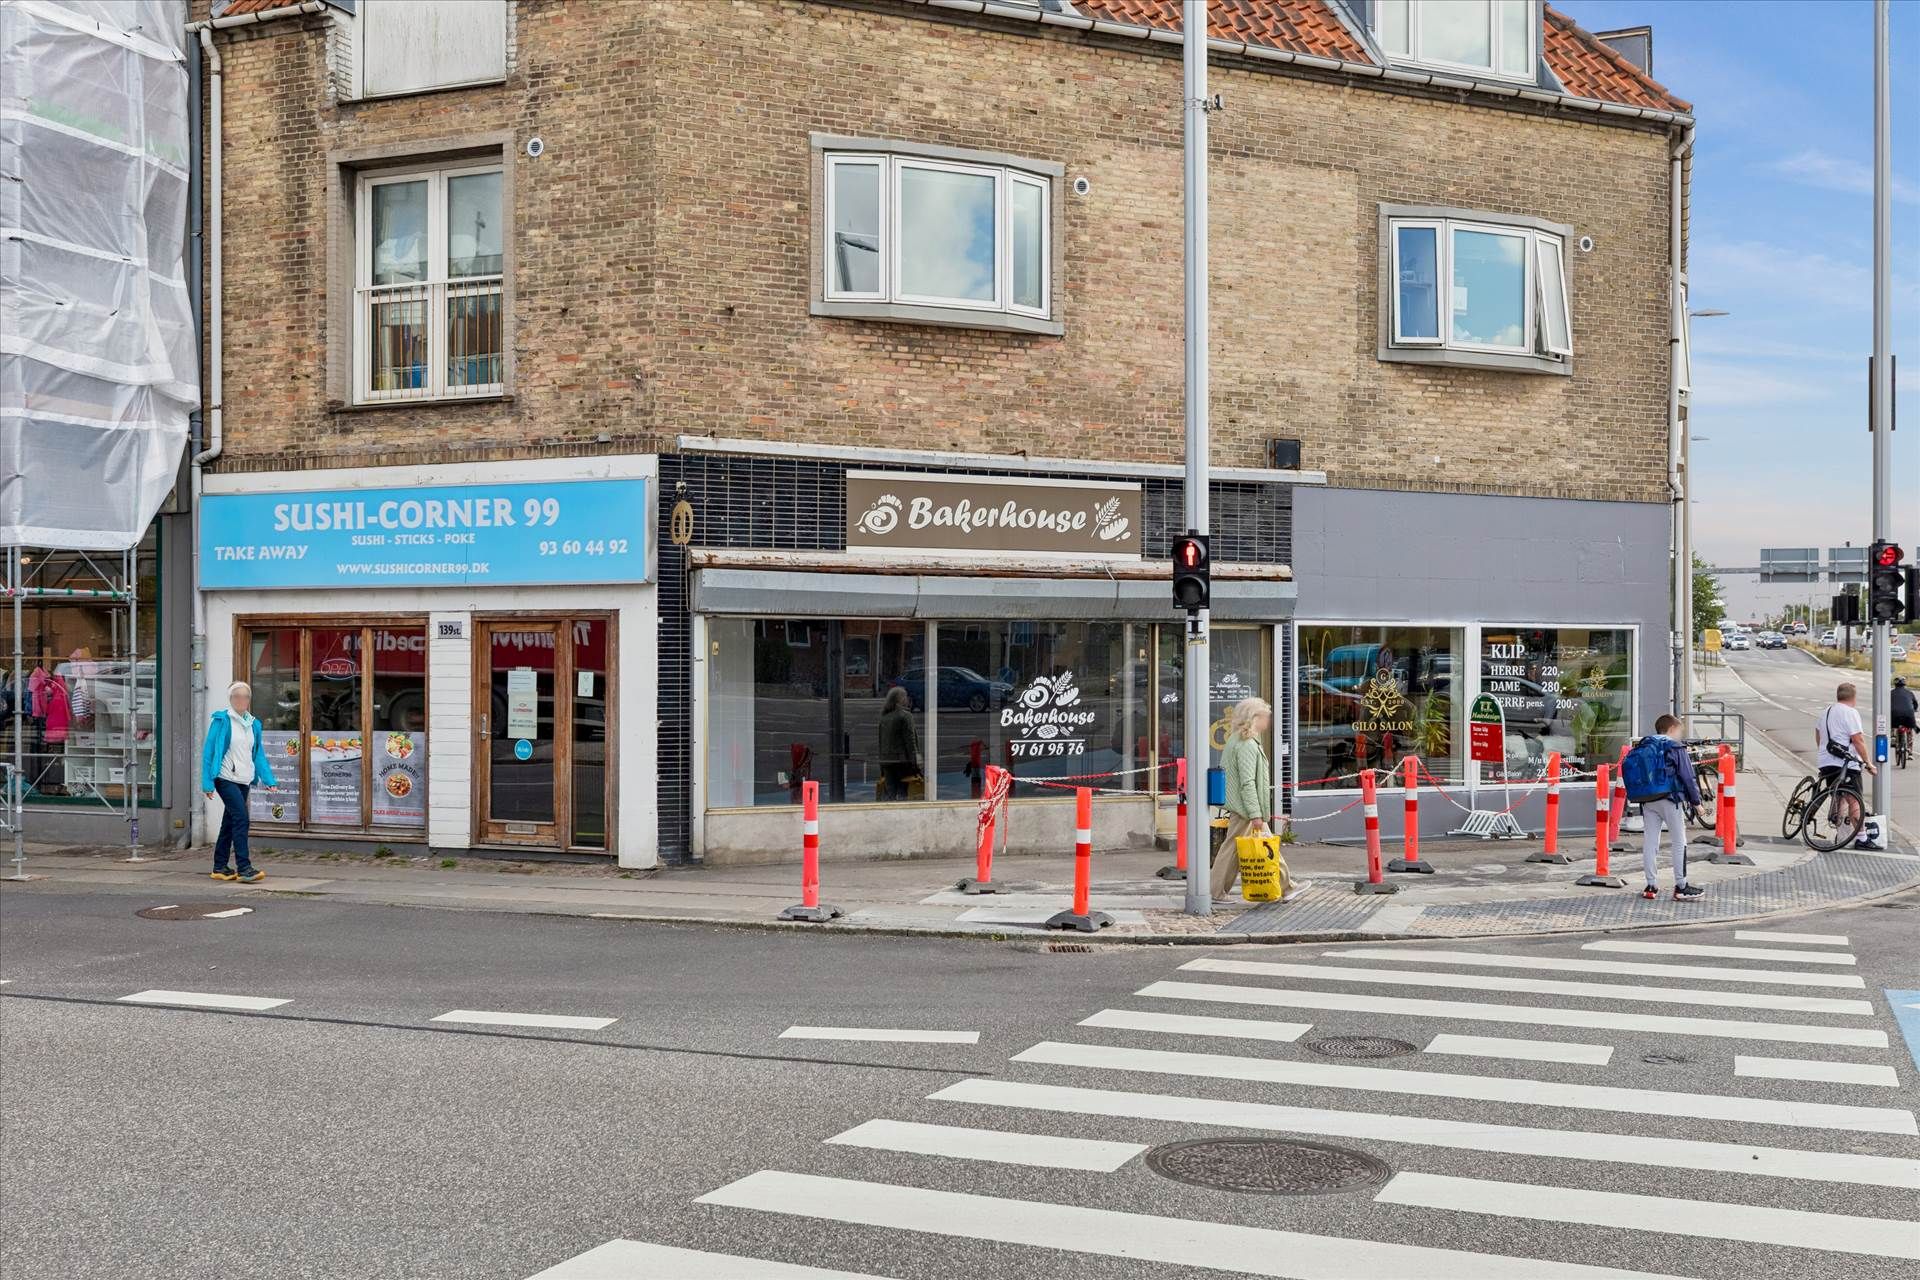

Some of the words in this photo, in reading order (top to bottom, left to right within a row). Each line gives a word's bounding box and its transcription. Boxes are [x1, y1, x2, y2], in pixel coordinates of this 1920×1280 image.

[274, 498, 516, 531] SUSHI-CORNER
[523, 497, 560, 527] 99
[908, 497, 1087, 533] Bakerhouse
[352, 534, 385, 545] SUSHI
[394, 533, 435, 545] STICKS
[444, 532, 476, 544] POKE
[214, 546, 254, 560] TAKE
[259, 545, 308, 560] AWAY
[539, 541, 557, 555] 93
[562, 540, 581, 554] 60
[585, 540, 604, 555] 44
[609, 539, 628, 553] 92
[336, 562, 489, 574] WWW.SUSHICORNER99.DK
[1490, 644, 1525, 658] KLIP
[320, 663, 355, 675] OPEN
[1490, 665, 1525, 676] HERRE
[1541, 666, 1564, 677] 220,-
[1490, 681, 1520, 692] DAME
[1541, 681, 1567, 694] 280,-
[1526, 700, 1544, 709] pens.
[1555, 699, 1578, 709] 200,-
[1000, 708, 1096, 727] Bakerhouse
[1351, 721, 1377, 731] GILO
[1379, 720, 1413, 731] SALON
[1011, 743, 1025, 756] 91
[1029, 743, 1044, 756] 61
[1067, 743, 1084, 755] 76
